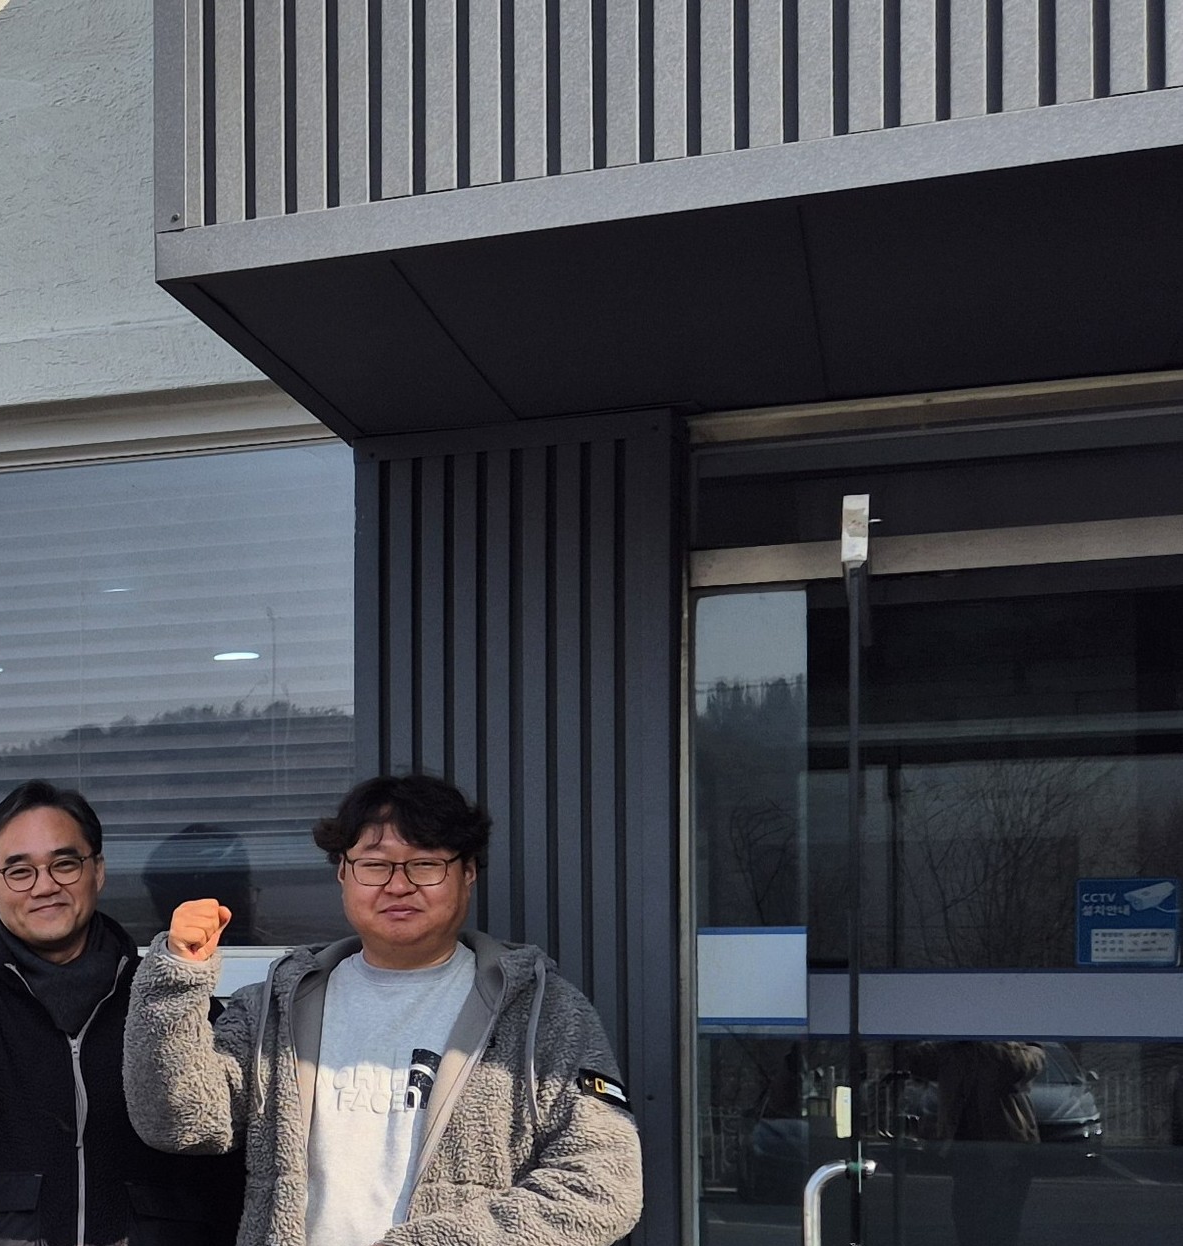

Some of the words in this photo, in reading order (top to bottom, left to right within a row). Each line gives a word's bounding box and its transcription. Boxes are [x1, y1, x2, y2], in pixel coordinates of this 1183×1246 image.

[1082, 893, 1116, 903] CCTV
[1082, 904, 1130, 917] 설치안내
[337, 1089, 406, 1114] FACE
